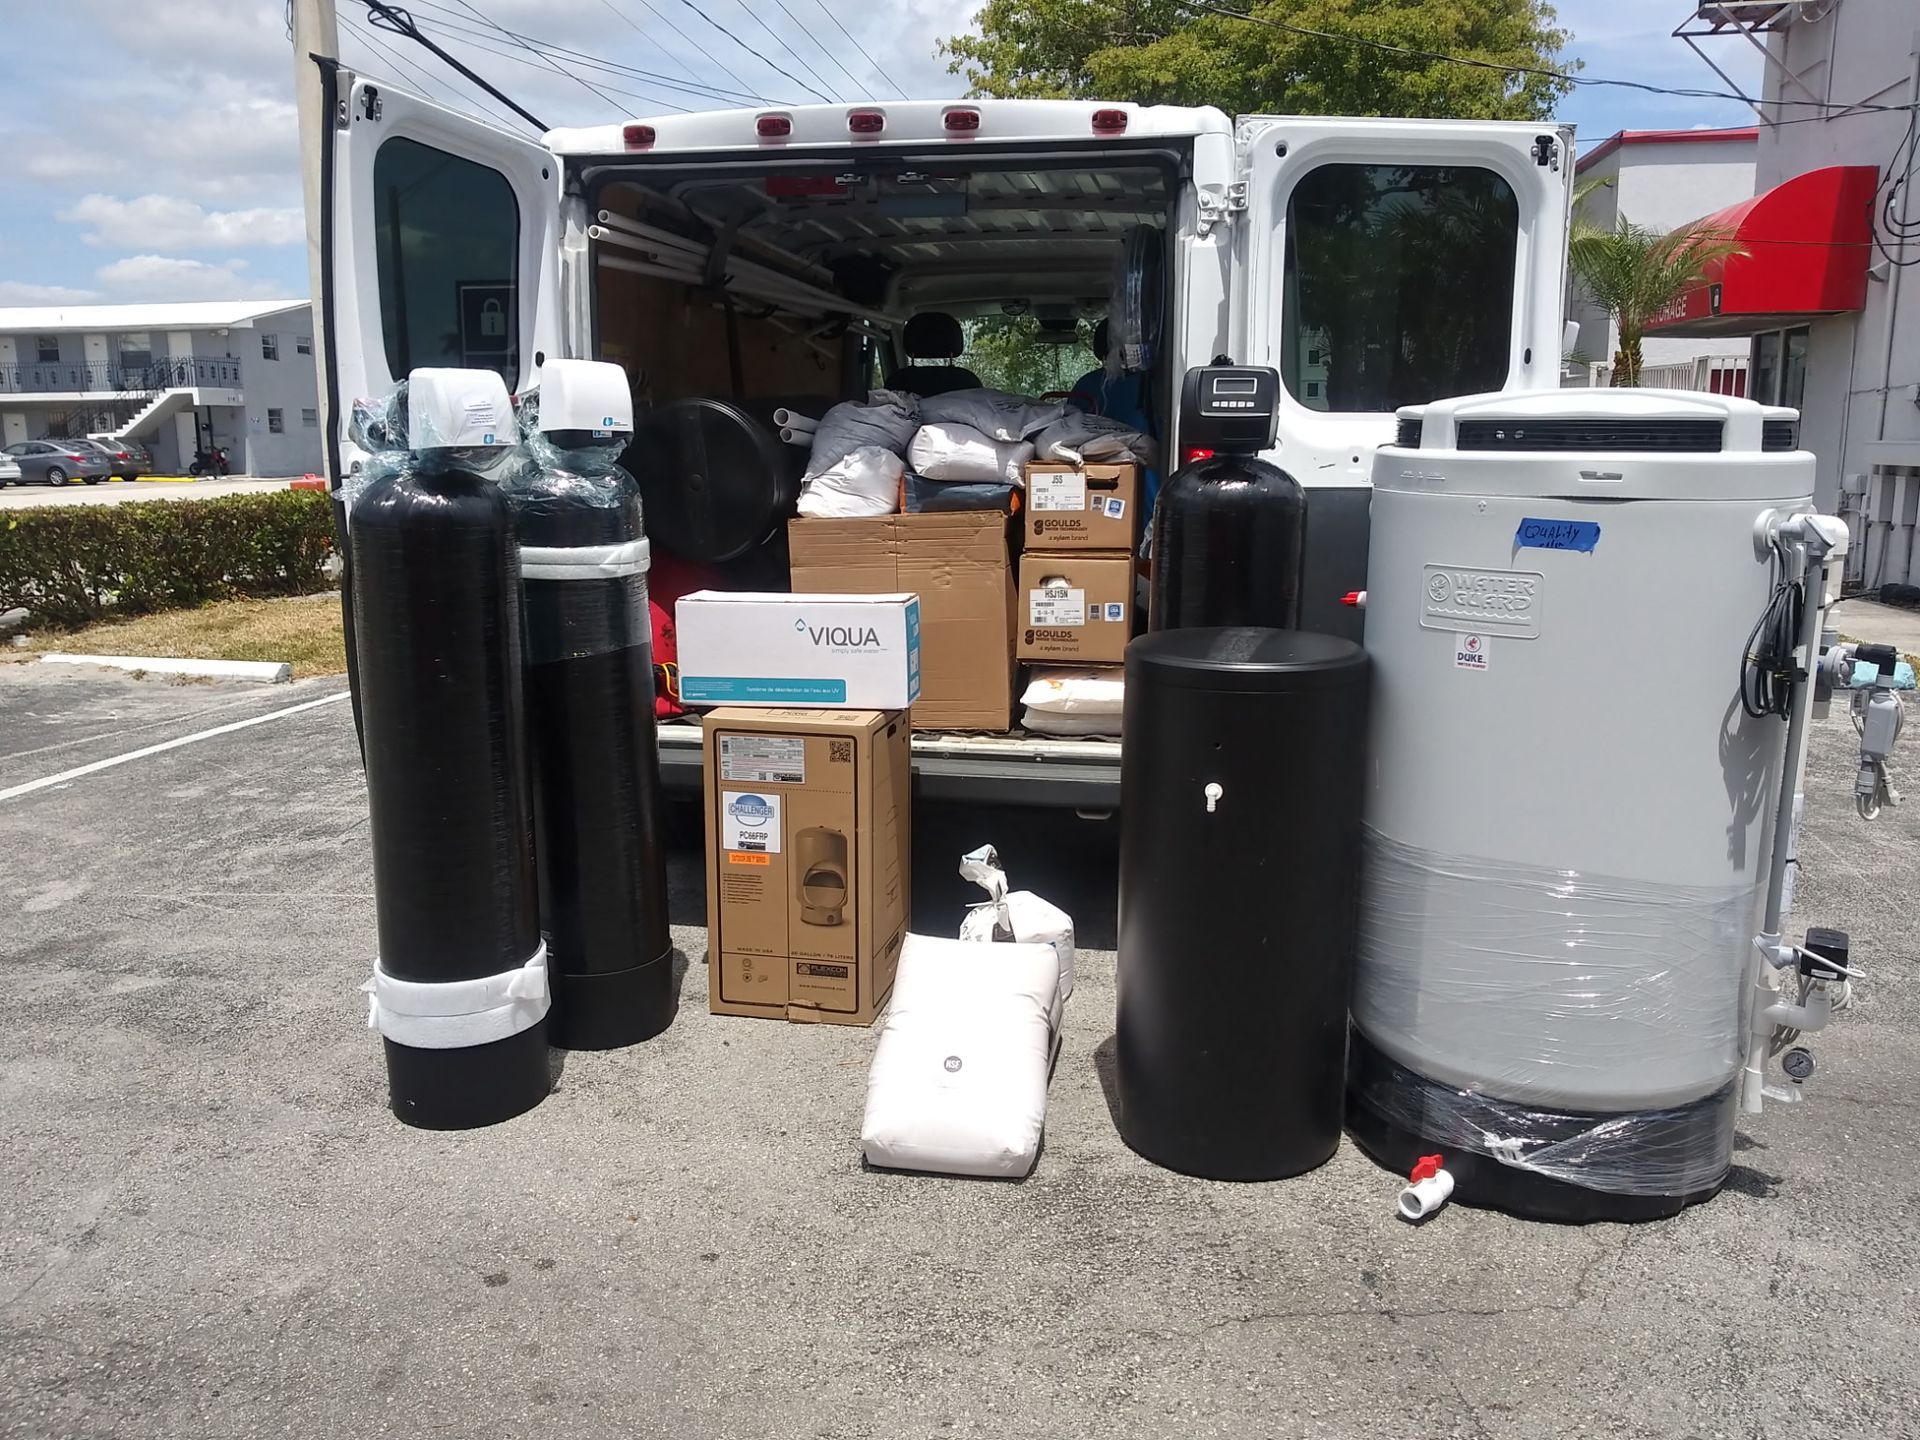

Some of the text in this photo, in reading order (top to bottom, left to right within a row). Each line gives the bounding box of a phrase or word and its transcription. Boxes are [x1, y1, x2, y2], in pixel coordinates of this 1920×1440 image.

[1052, 475, 1063, 484] J5S
[1044, 519, 1081, 527] GOULDS
[1454, 574, 1535, 596] WATER
[1045, 590, 1068, 598] HSJ15N
[1454, 591, 1532, 612] GUARD
[808, 626, 880, 646] VIQUA
[1035, 630, 1072, 638] GOULDS
[1457, 652, 1484, 664] DUKE
[730, 804, 773, 816] CHALLENGER
